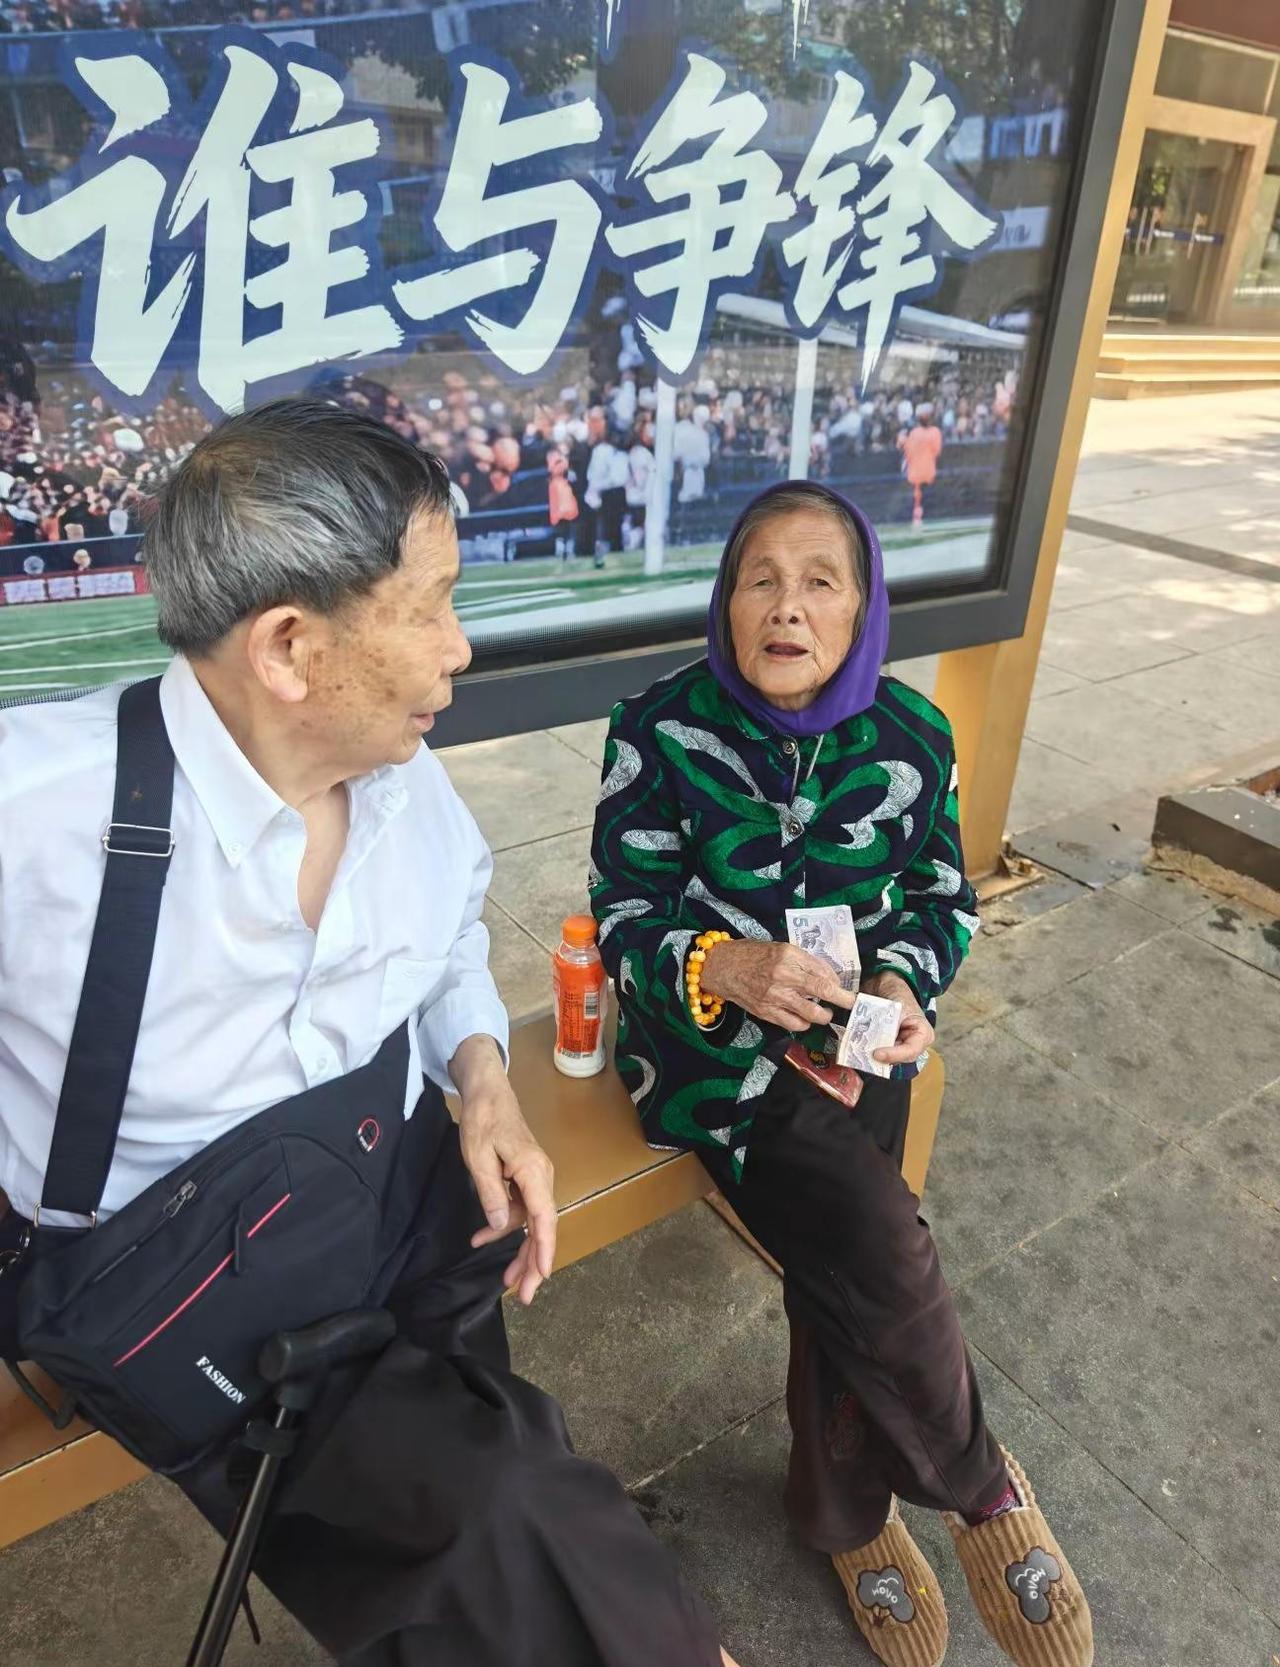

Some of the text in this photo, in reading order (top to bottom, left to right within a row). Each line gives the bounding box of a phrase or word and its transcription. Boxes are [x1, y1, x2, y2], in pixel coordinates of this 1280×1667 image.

[6, 46, 997, 413] 谁与争锋
[196, 1355, 246, 1404] FASHION
